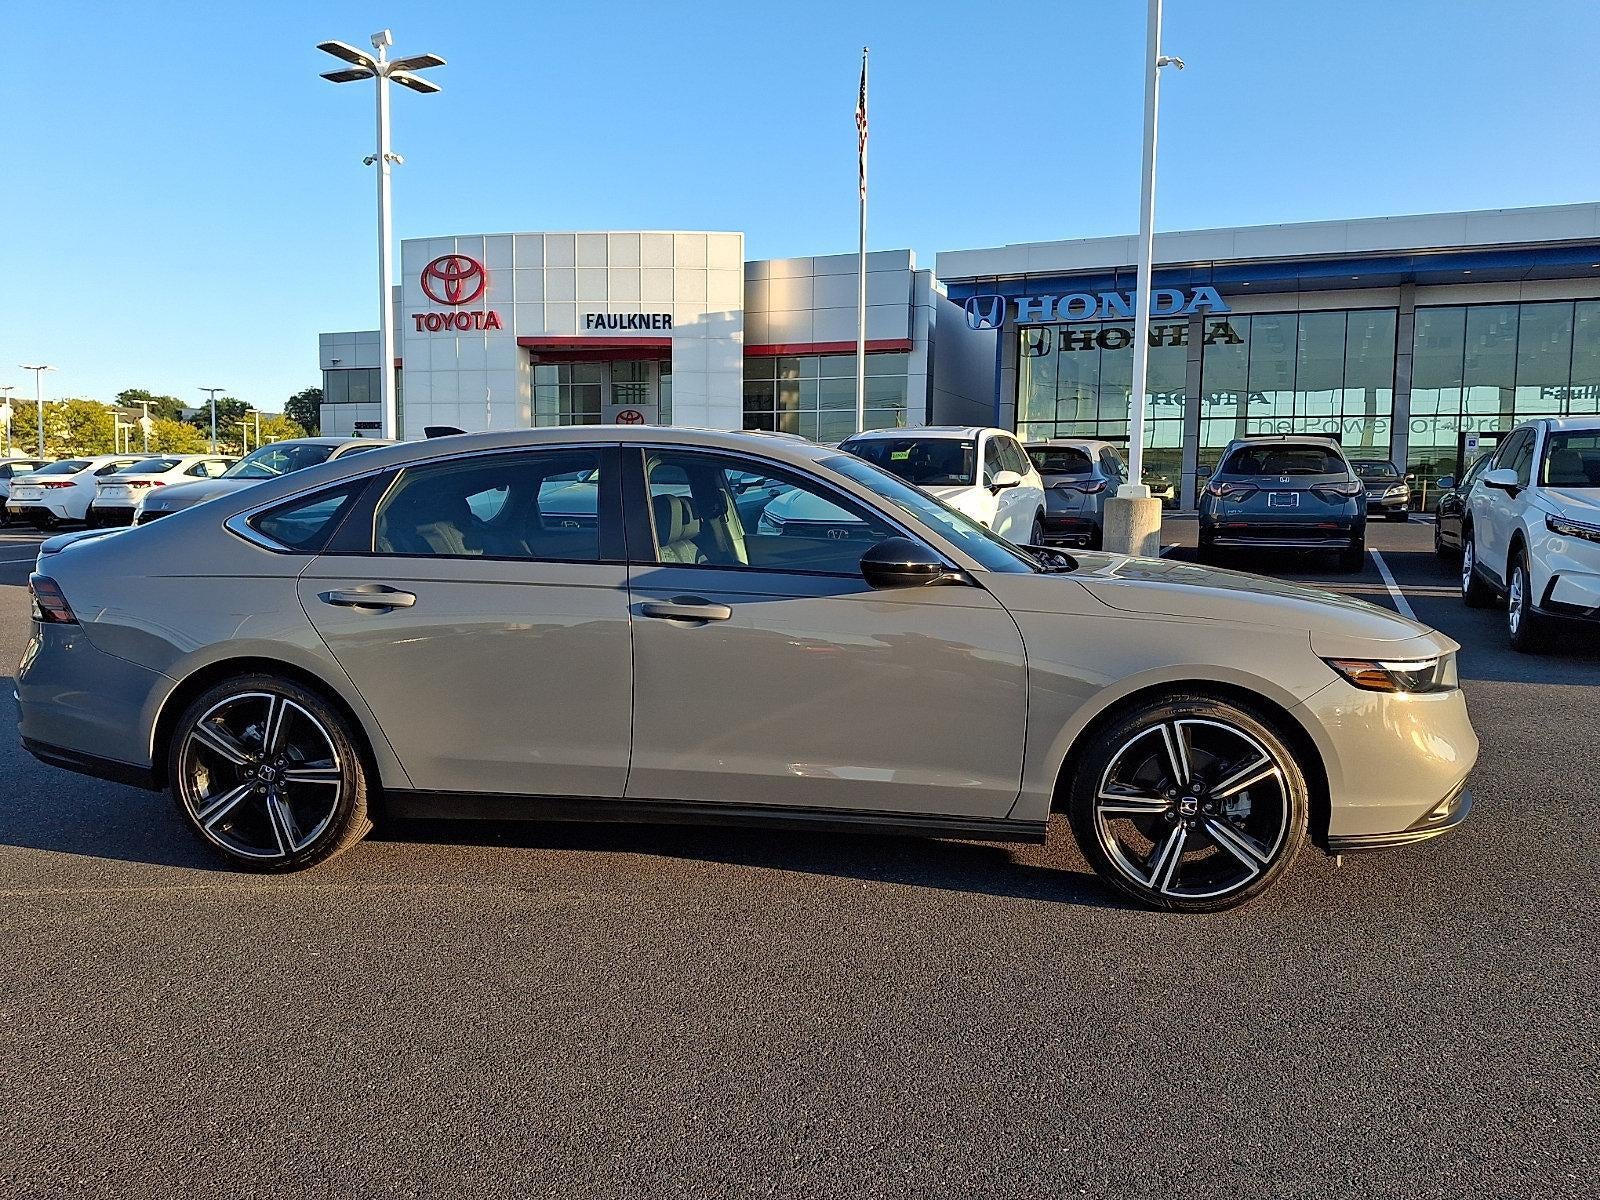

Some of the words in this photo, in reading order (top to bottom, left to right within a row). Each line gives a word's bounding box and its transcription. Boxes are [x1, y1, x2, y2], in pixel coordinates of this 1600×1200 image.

[1014, 286, 1231, 323] HONDA
[412, 311, 500, 331] TOYOTA
[586, 313, 672, 330] FAULKNER
